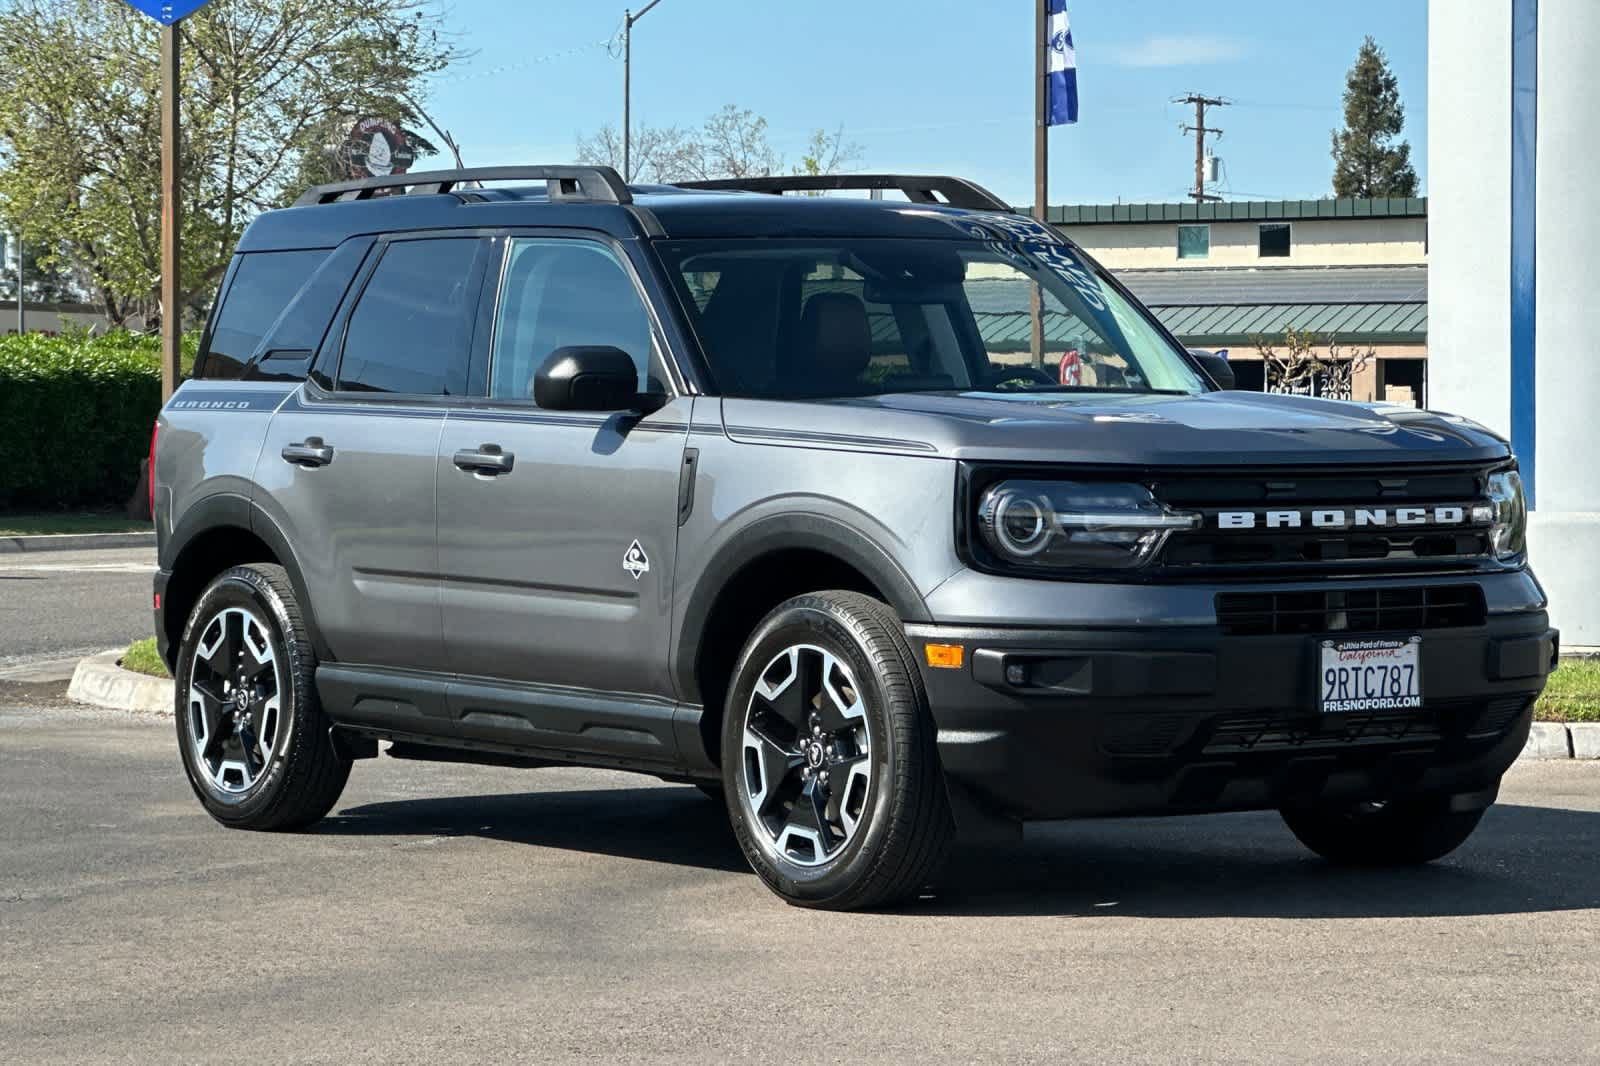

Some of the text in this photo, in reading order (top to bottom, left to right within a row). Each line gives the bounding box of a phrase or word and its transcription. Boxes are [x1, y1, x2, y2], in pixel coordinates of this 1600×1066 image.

[174, 400, 250, 409] BRONCO
[1218, 507, 1463, 529] BRONCO
[1343, 641, 1360, 650] Lithia
[1360, 640, 1373, 649] Ford
[1373, 640, 1380, 648] of
[1380, 640, 1398, 648] Fresno
[1339, 648, 1397, 664] California
[1325, 664, 1414, 701] 9RTC787
[1323, 696, 1421, 713] FRESNOFORD.COM
